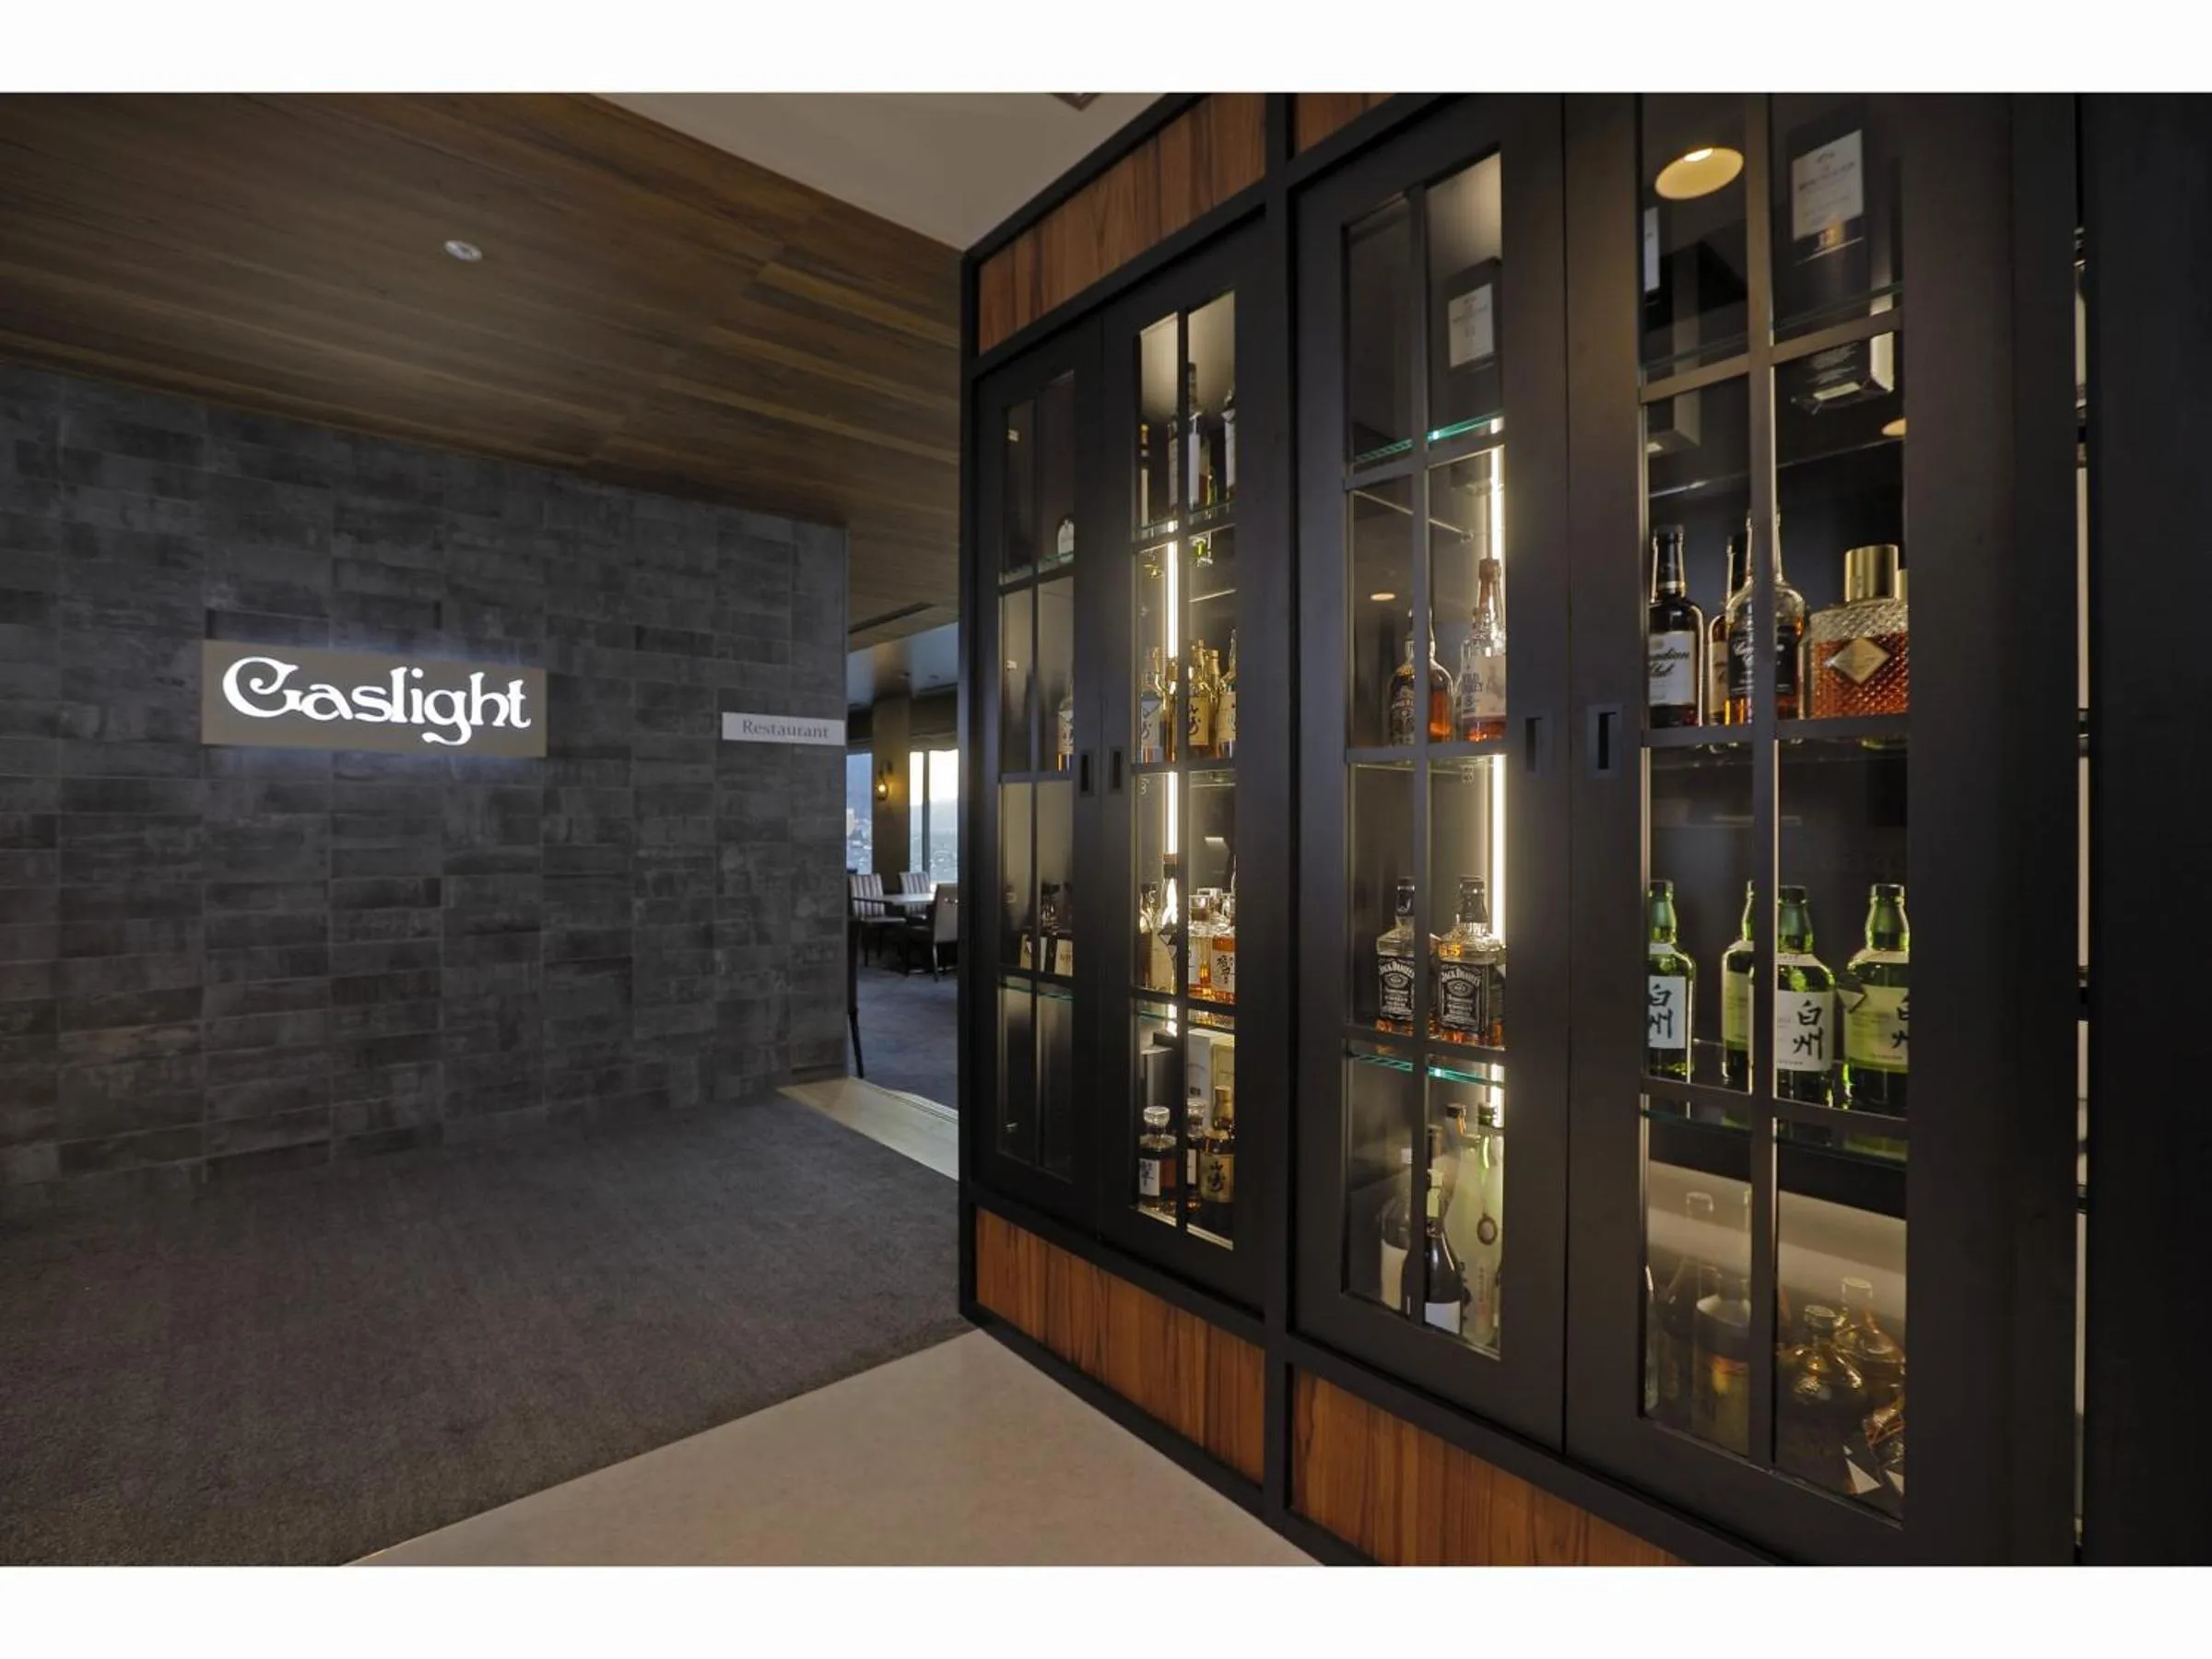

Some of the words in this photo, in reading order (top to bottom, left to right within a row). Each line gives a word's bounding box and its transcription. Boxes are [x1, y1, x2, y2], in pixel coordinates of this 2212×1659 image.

[223, 655, 532, 746] Gaslight
[742, 718, 829, 738] Restaurant
[1793, 999, 1824, 1060] 白州
